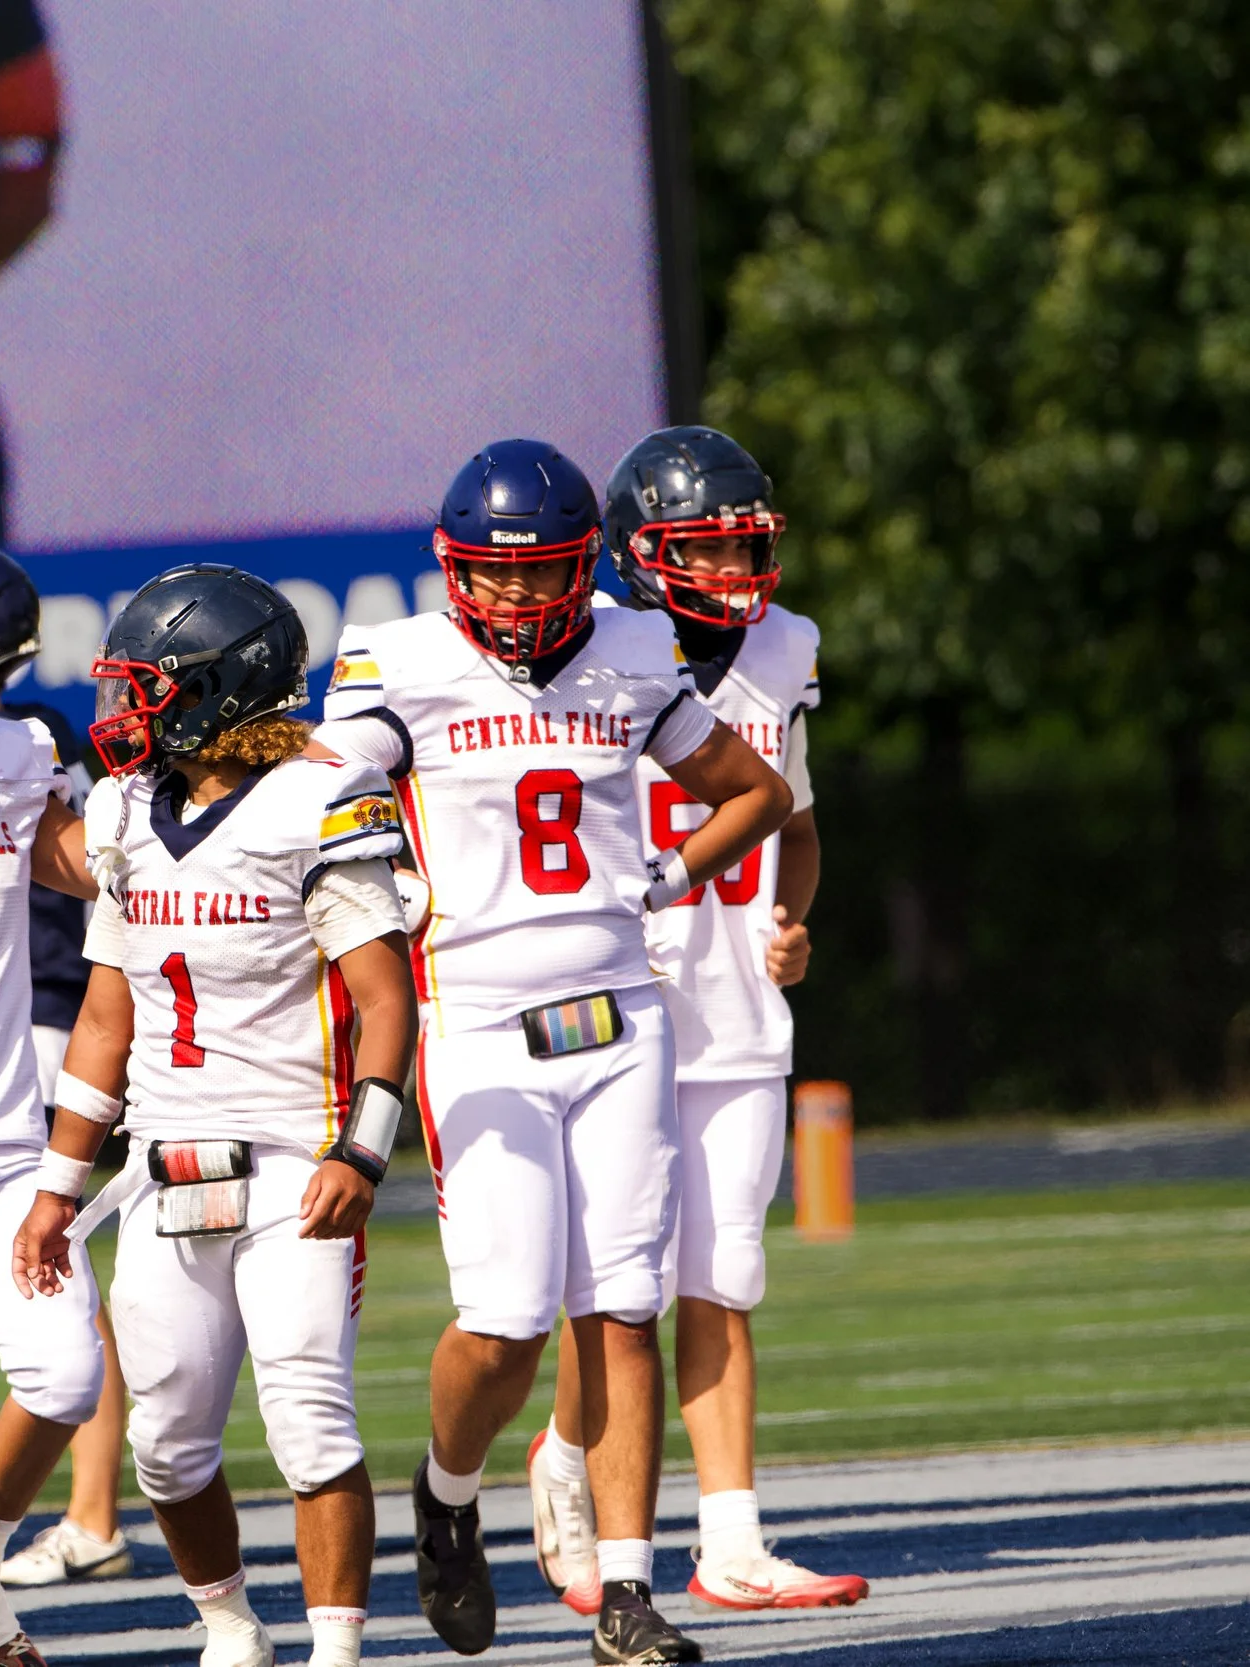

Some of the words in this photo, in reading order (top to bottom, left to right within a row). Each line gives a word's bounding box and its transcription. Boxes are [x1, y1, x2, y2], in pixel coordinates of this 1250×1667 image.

[491, 530, 537, 544] Riddell
[448, 712, 558, 755] CENTRAL
[565, 711, 631, 749] FALLS
[515, 768, 591, 896] 8
[193, 891, 272, 926] FALLS
[159, 952, 206, 1068] 1
